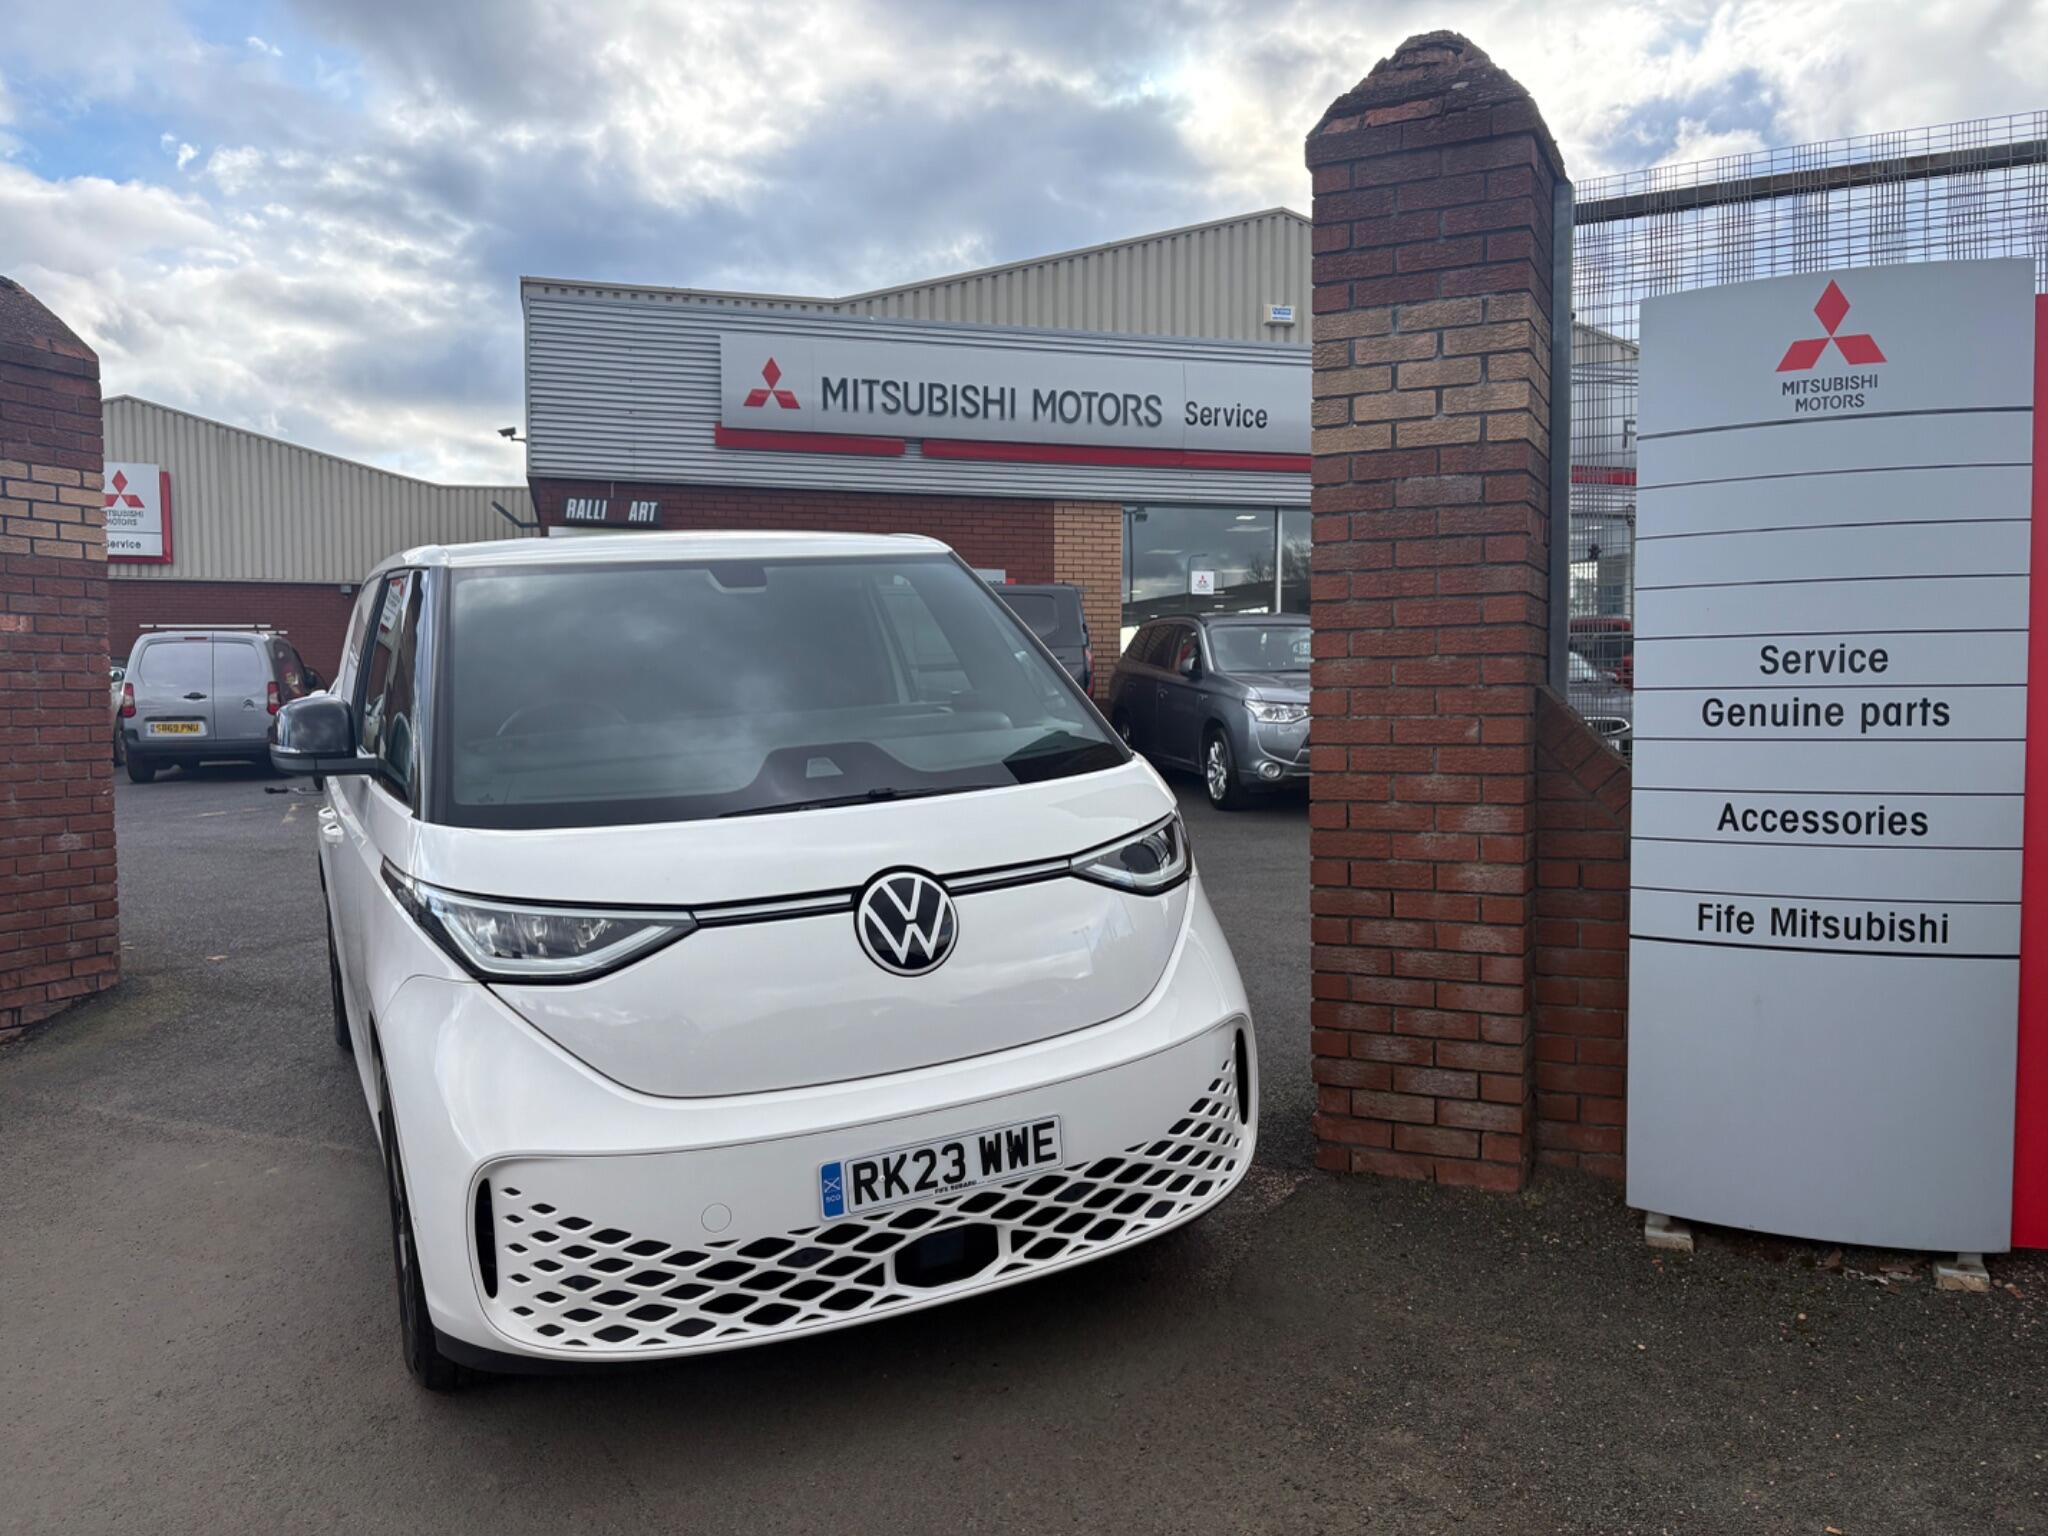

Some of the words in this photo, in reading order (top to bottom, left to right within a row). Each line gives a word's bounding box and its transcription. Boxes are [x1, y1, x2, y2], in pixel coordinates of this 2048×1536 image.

[1781, 373, 1878, 396] MITSUBISHI
[821, 376, 1016, 420] MITSUBISHI
[1032, 388, 1163, 428] MOTORS
[1184, 401, 1268, 429] Service
[1794, 393, 1866, 413] MOTORS
[565, 498, 608, 520] RALLI
[627, 500, 658, 522] ART
[1760, 643, 1889, 675] Service
[1702, 697, 1844, 727] Genuine
[1861, 697, 1950, 734] parts
[1717, 802, 1929, 836] Accessories
[1698, 902, 1755, 935] Fife
[1770, 907, 1949, 944] Mitsubishi
[852, 1142, 966, 1206] RK23
[978, 1120, 1057, 1176] WWE
